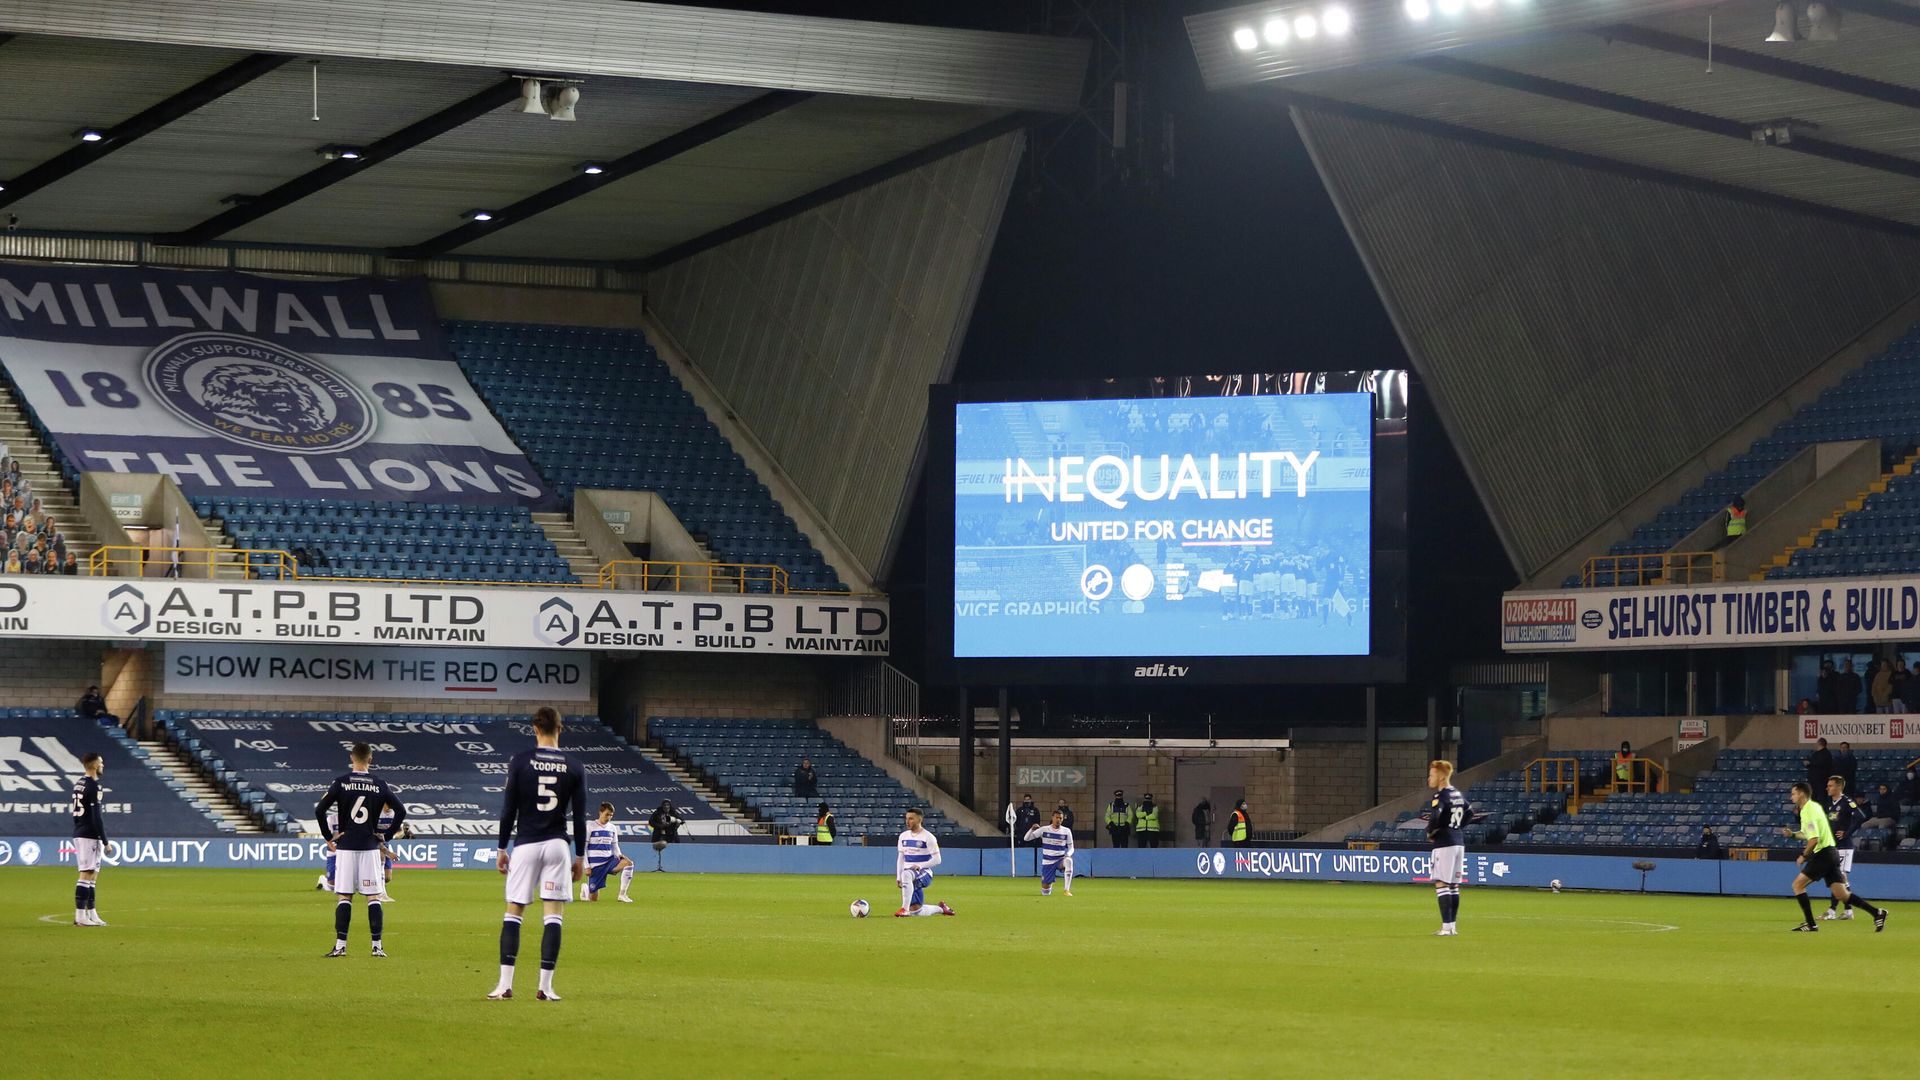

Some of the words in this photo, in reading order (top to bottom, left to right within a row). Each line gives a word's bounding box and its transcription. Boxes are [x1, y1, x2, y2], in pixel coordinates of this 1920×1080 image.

[0, 278, 421, 342] MILLWALL
[44, 368, 140, 409] 18
[164, 352, 195, 393] MILLWALL
[311, 372, 350, 399] CLUB
[371, 380, 472, 422] 85
[213, 418, 243, 434] WE
[250, 430, 298, 446] FEAR
[302, 434, 330, 445] NO
[84, 449, 274, 488] THE
[287, 455, 543, 499] LIONS
[1003, 451, 1321, 509] INEQUALITY
[1051, 521, 1129, 542] UNITED
[1134, 519, 1177, 540] FOR
[1181, 518, 1273, 540] CHANGE
[158, 586, 361, 622] A.T.P.B
[385, 594, 485, 625] LTD
[586, 599, 774, 633] A.T.P.B
[795, 605, 888, 636] LTD
[1506, 600, 1574, 623] 0208-683-4411
[1608, 593, 1716, 640] SELHURST
[1722, 589, 1810, 635] TIMBER
[1820, 588, 1836, 633] &
[1846, 585, 1918, 632] BUILD
[156, 619, 242, 636] DESIGN
[275, 622, 341, 638] BUILD
[373, 625, 485, 642] MAINTAIN
[584, 632, 664, 647] DESIGN
[694, 635, 756, 649] BUILD
[785, 637, 889, 653] MAINTAIN
[176, 655, 260, 679] SHOW
[270, 657, 374, 681] RACISM
[382, 659, 436, 682] THE
[444, 661, 498, 683] RED
[506, 663, 580, 685] CARD
[1134, 663, 1189, 678] adi.tv
[1819, 723, 1885, 735] MANSIONBET
[533, 762, 568, 774] COOPER
[1030, 769, 1064, 784] EXIT
[344, 782, 381, 794] WILLIAMS
[536, 776, 559, 812] 5
[350, 795, 369, 825] 6
[58, 840, 210, 866] INQUALITY
[229, 842, 303, 861] UNITED
[1234, 851, 1322, 876] INEQUALITY
[1333, 854, 1380, 873] UNITED
[1383, 855, 1409, 874] FOR
[1412, 855, 1469, 876] CHE
